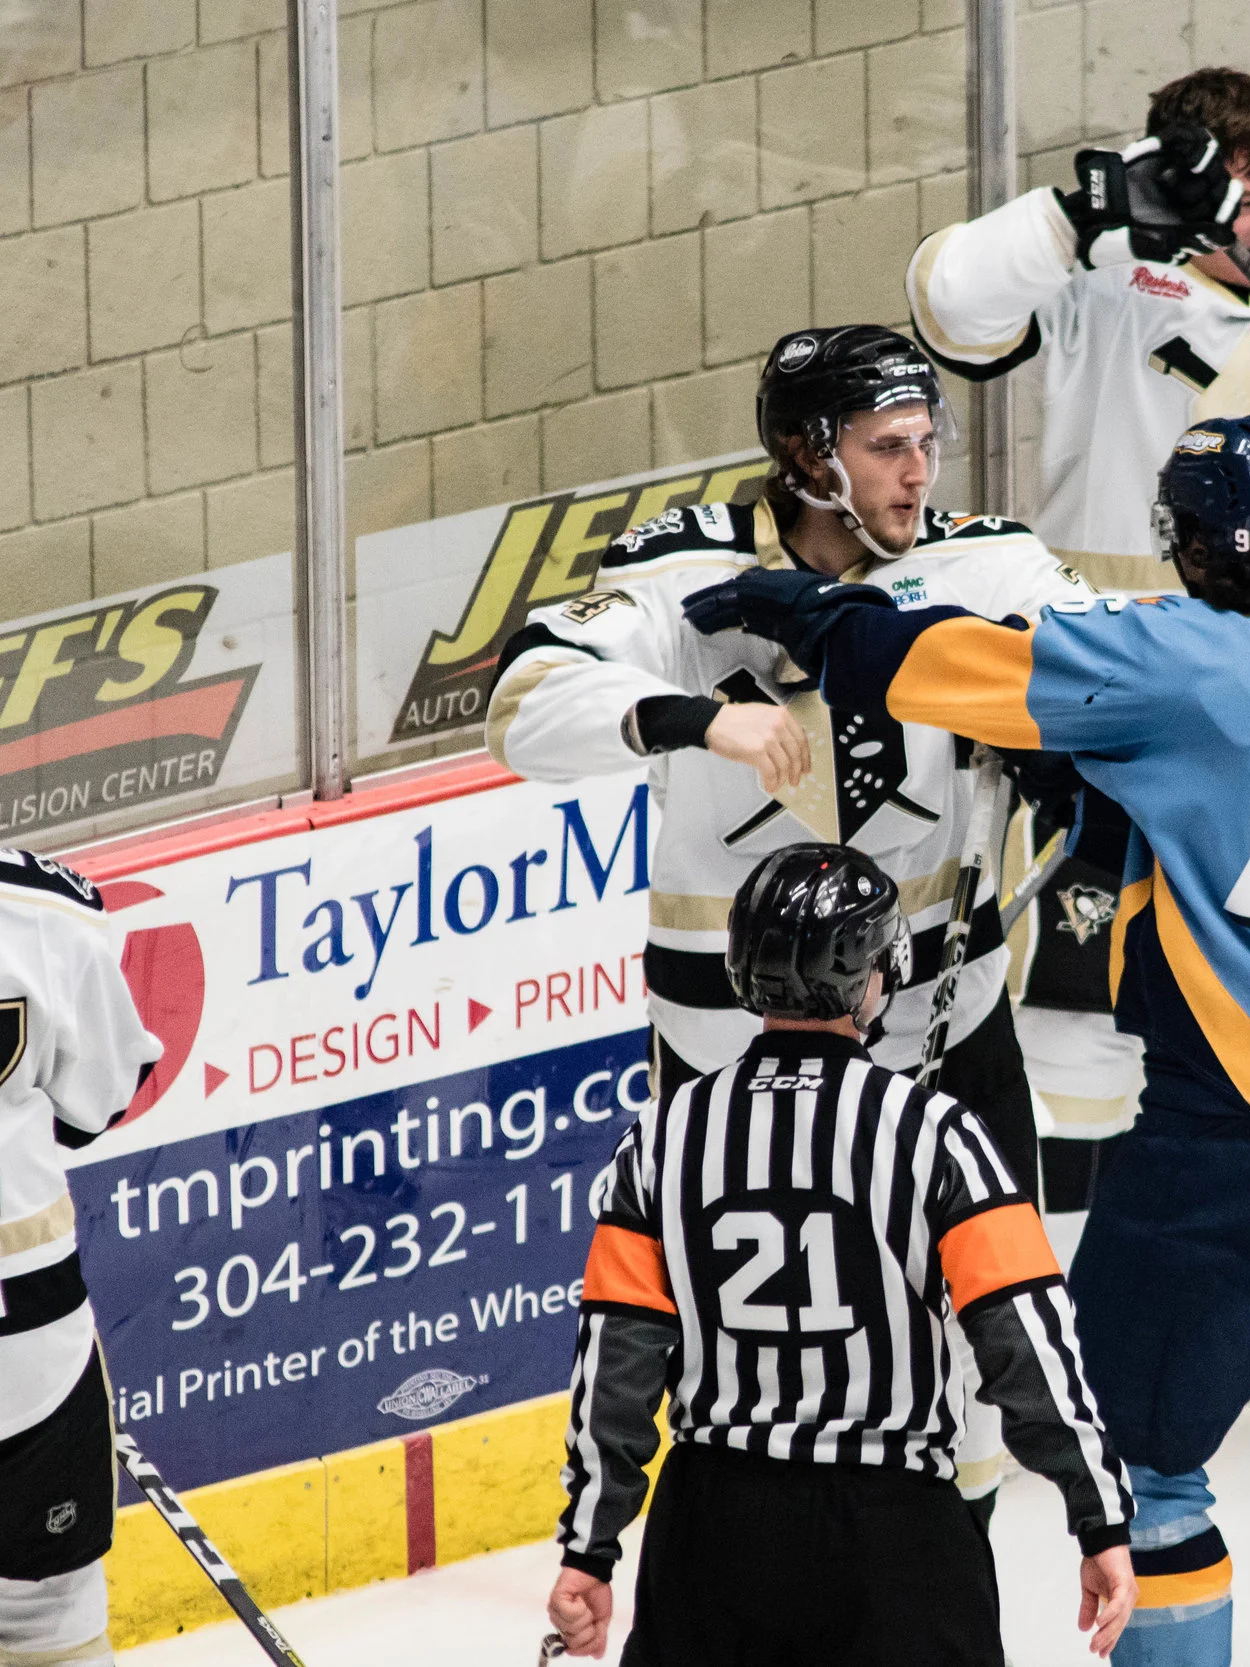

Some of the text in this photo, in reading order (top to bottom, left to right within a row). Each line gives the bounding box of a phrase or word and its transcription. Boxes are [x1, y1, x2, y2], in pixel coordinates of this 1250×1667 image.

[890, 363, 930, 377] CCM
[1234, 528, 1250, 552] 9
[402, 687, 480, 729] AUTO
[101, 749, 216, 802] CENTER
[225, 784, 650, 1001] TaylorM
[248, 1001, 442, 1095] DESIGN
[747, 1075, 823, 1092] CCM
[711, 1211, 855, 1333] 21
[113, 1376, 164, 1424] ial
[180, 1345, 327, 1409] Printer
[337, 1322, 381, 1368] of
[389, 1312, 459, 1355] the
